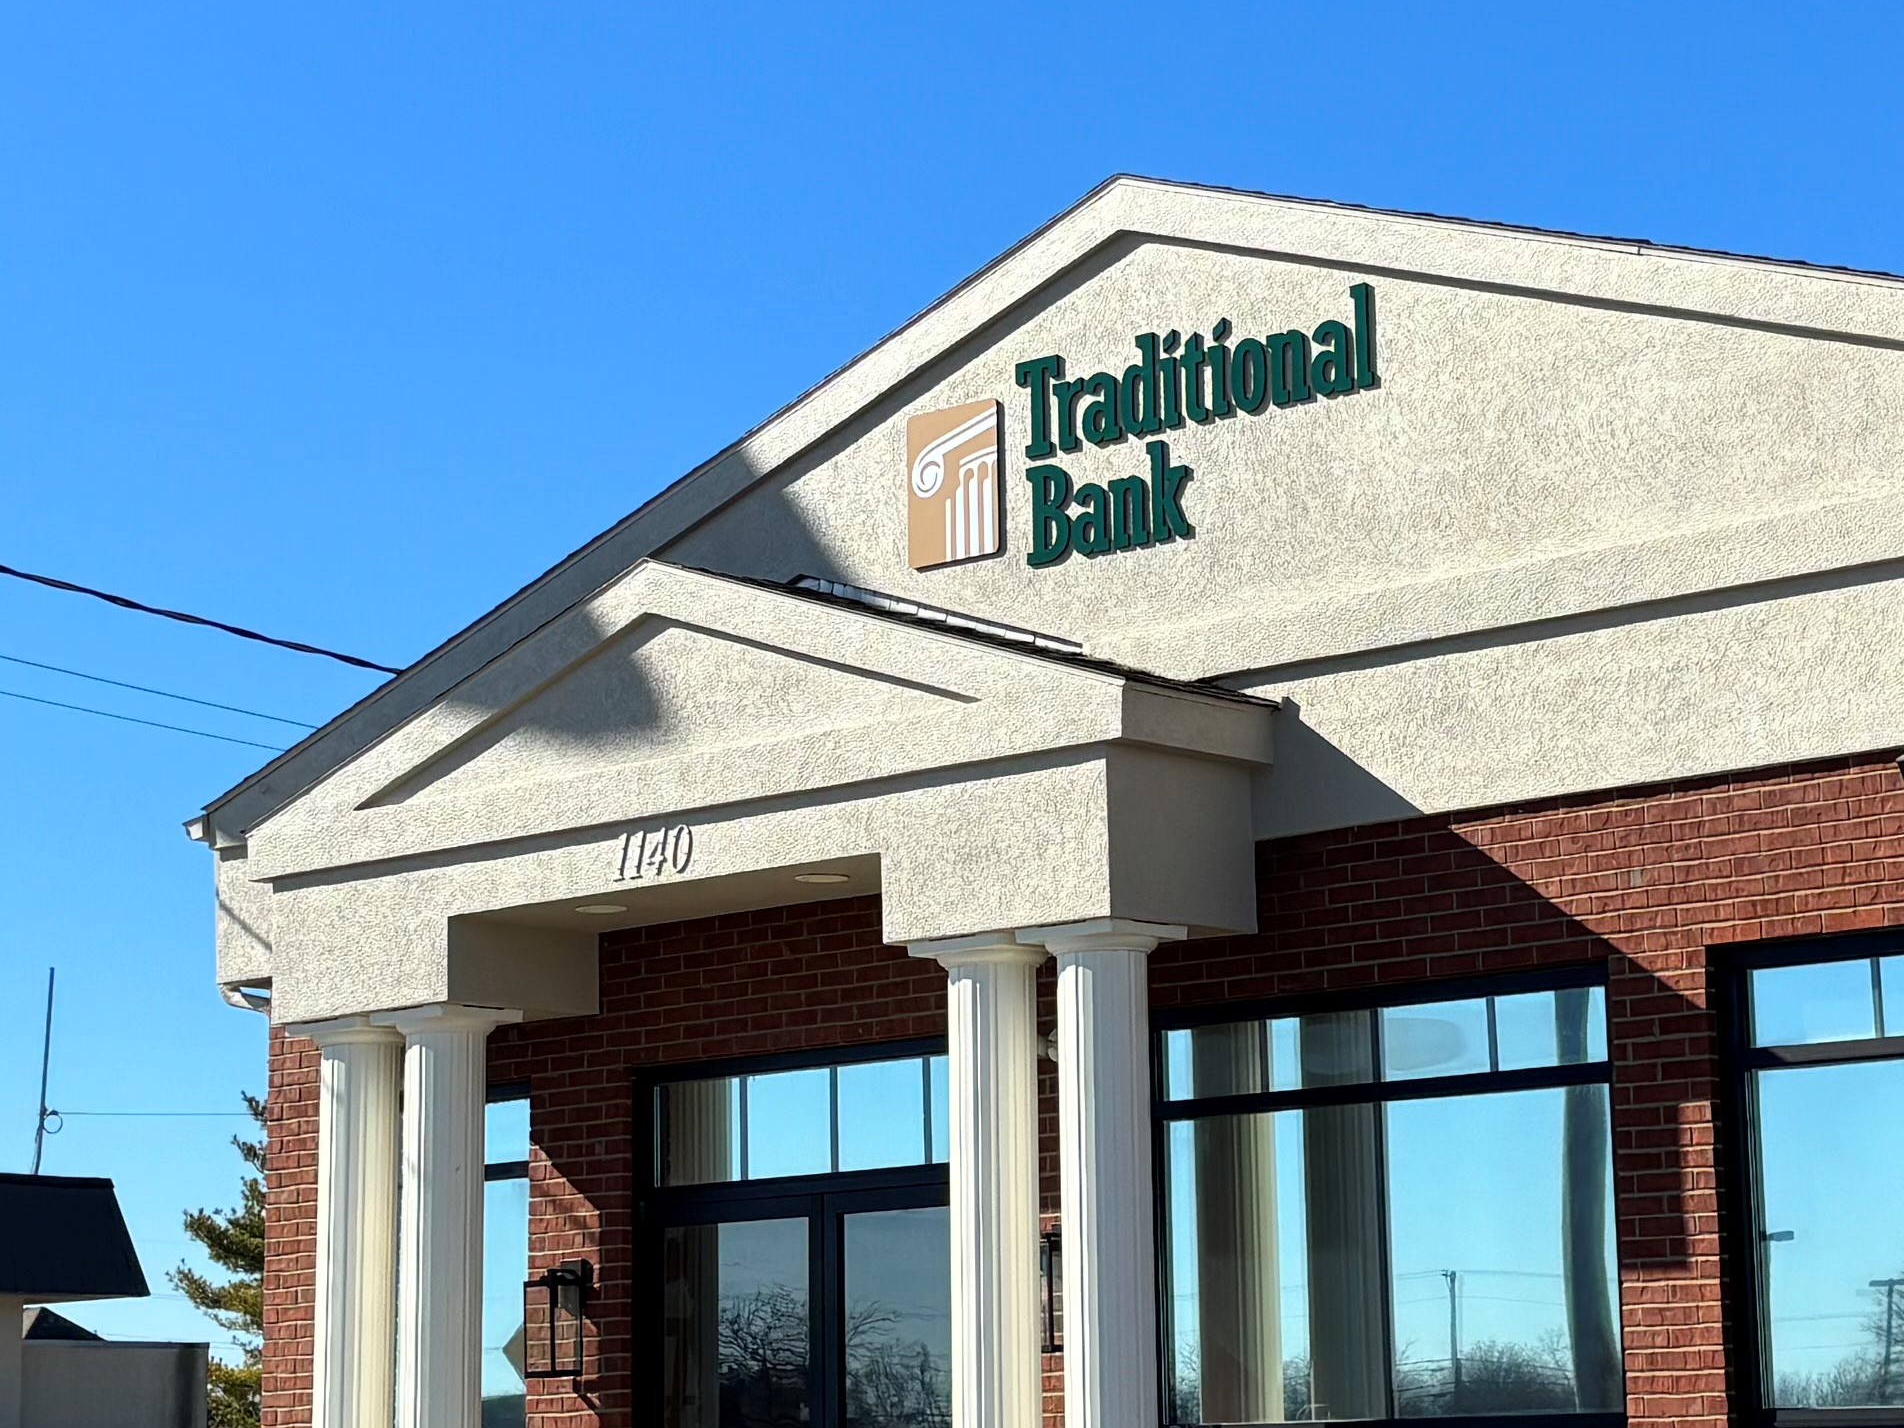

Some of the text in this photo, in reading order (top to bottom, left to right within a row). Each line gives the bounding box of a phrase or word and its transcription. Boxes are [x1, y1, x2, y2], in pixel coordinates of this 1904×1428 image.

[1015, 282, 1379, 460] Traditional
[1026, 440, 1194, 567] Bank
[613, 824, 693, 882] 1140
